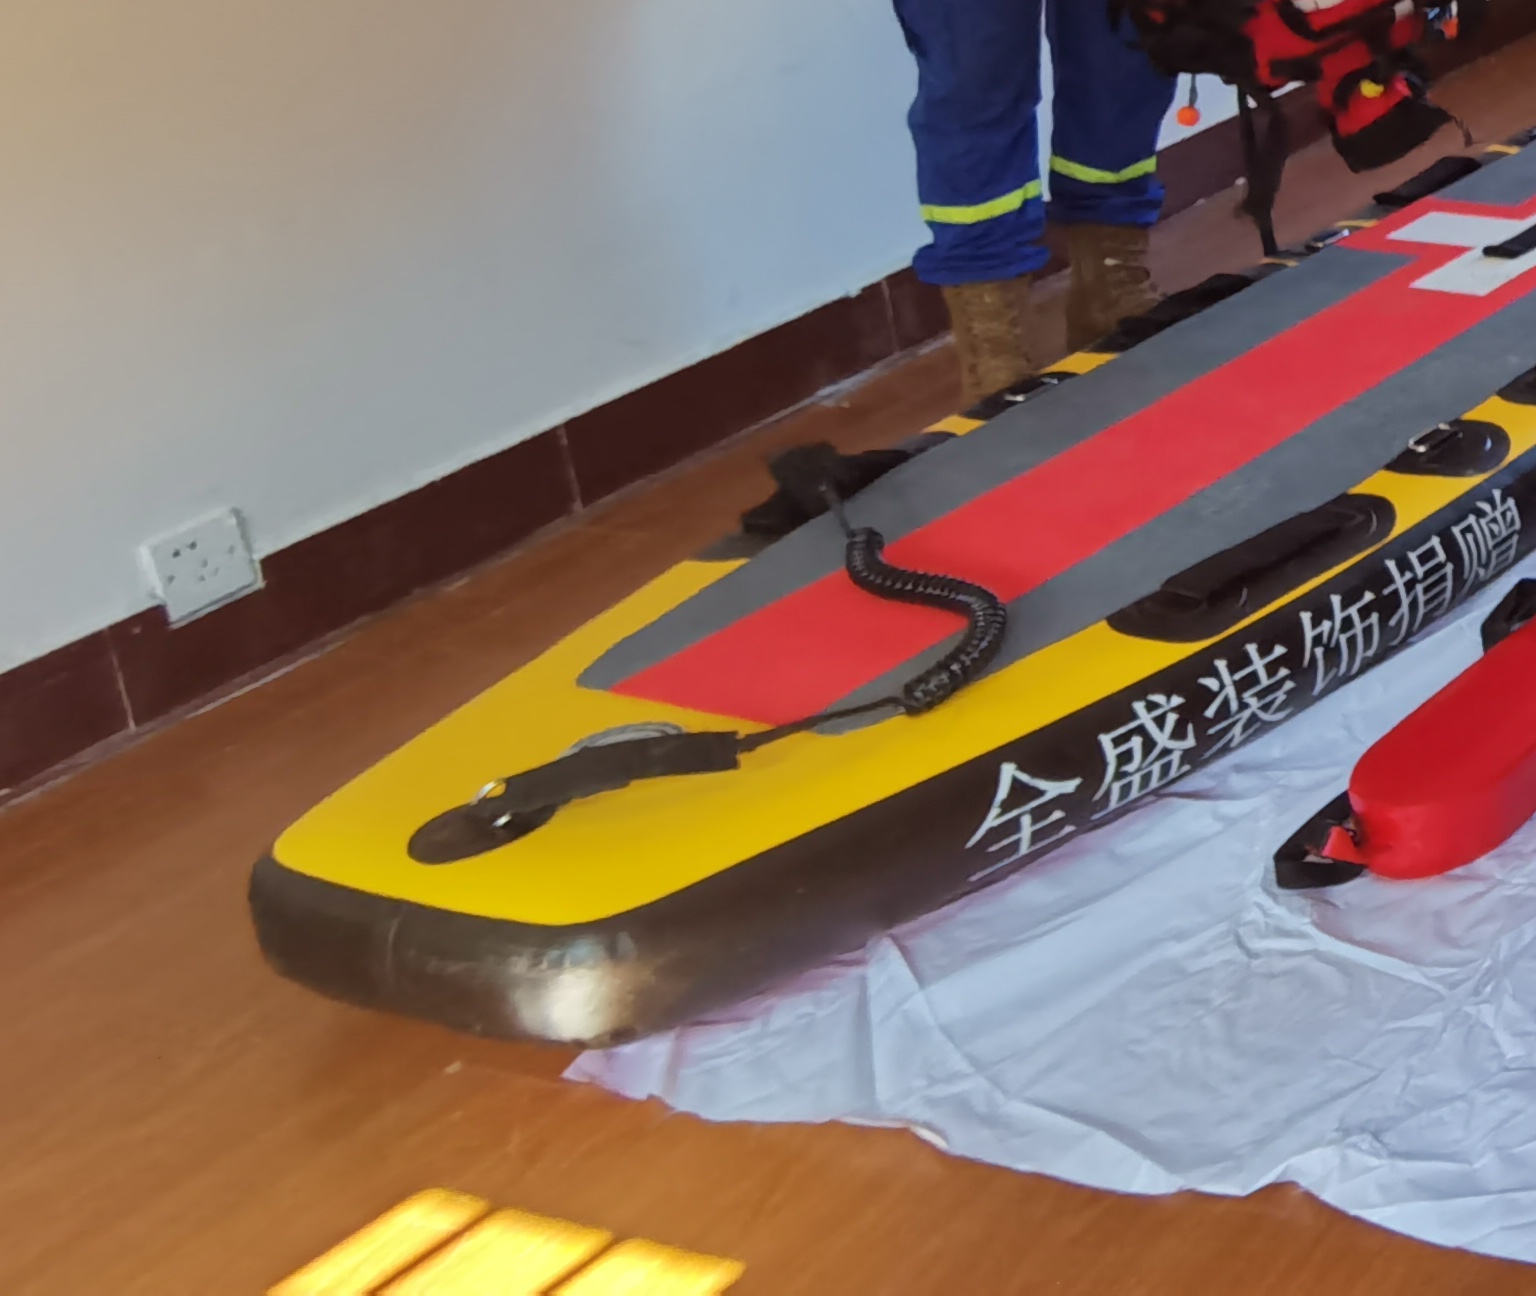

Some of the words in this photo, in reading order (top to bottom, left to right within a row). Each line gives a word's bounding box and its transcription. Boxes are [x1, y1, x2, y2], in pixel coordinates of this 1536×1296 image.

[964, 487, 1522, 882] 全盛装饰捐赠
